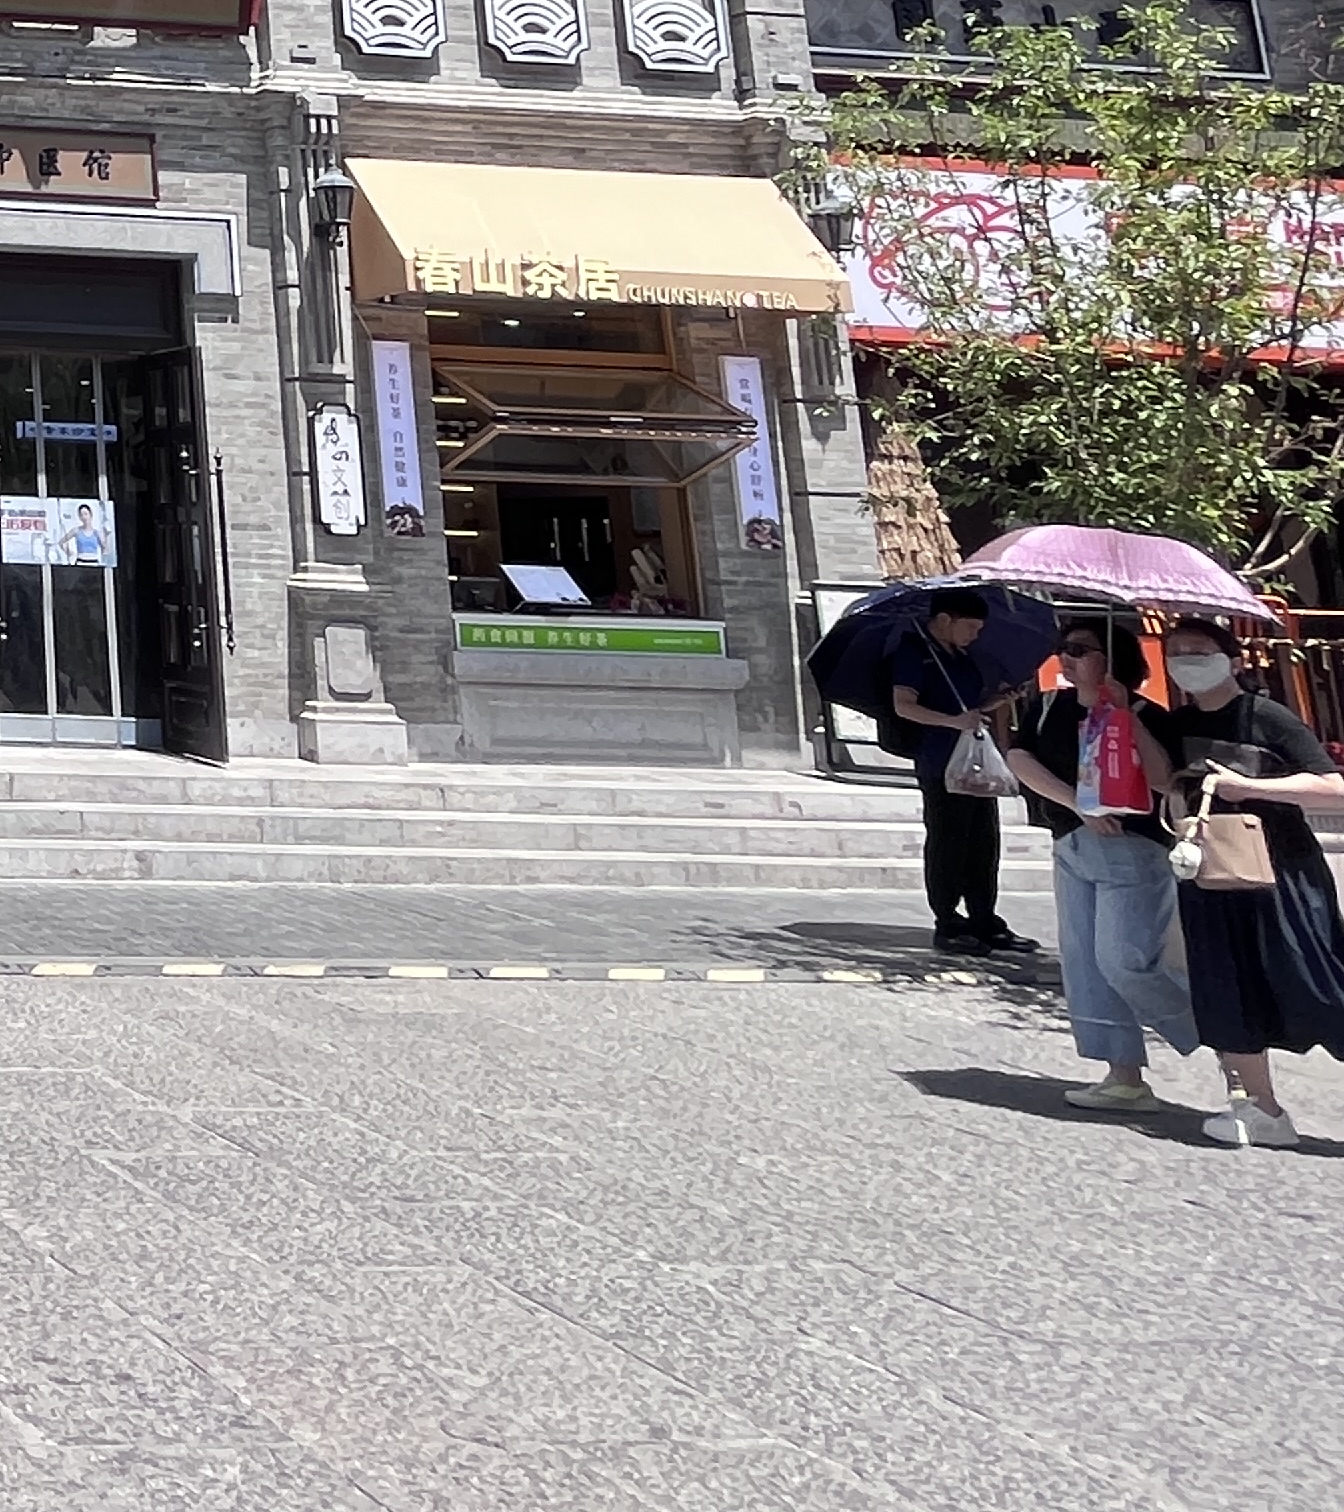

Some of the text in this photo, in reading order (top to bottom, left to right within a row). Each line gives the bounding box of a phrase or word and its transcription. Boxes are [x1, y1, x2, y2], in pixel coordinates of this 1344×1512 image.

[415, 245, 620, 301] 春山茶居
[627, 284, 799, 309] CHUNSHAN TEA
